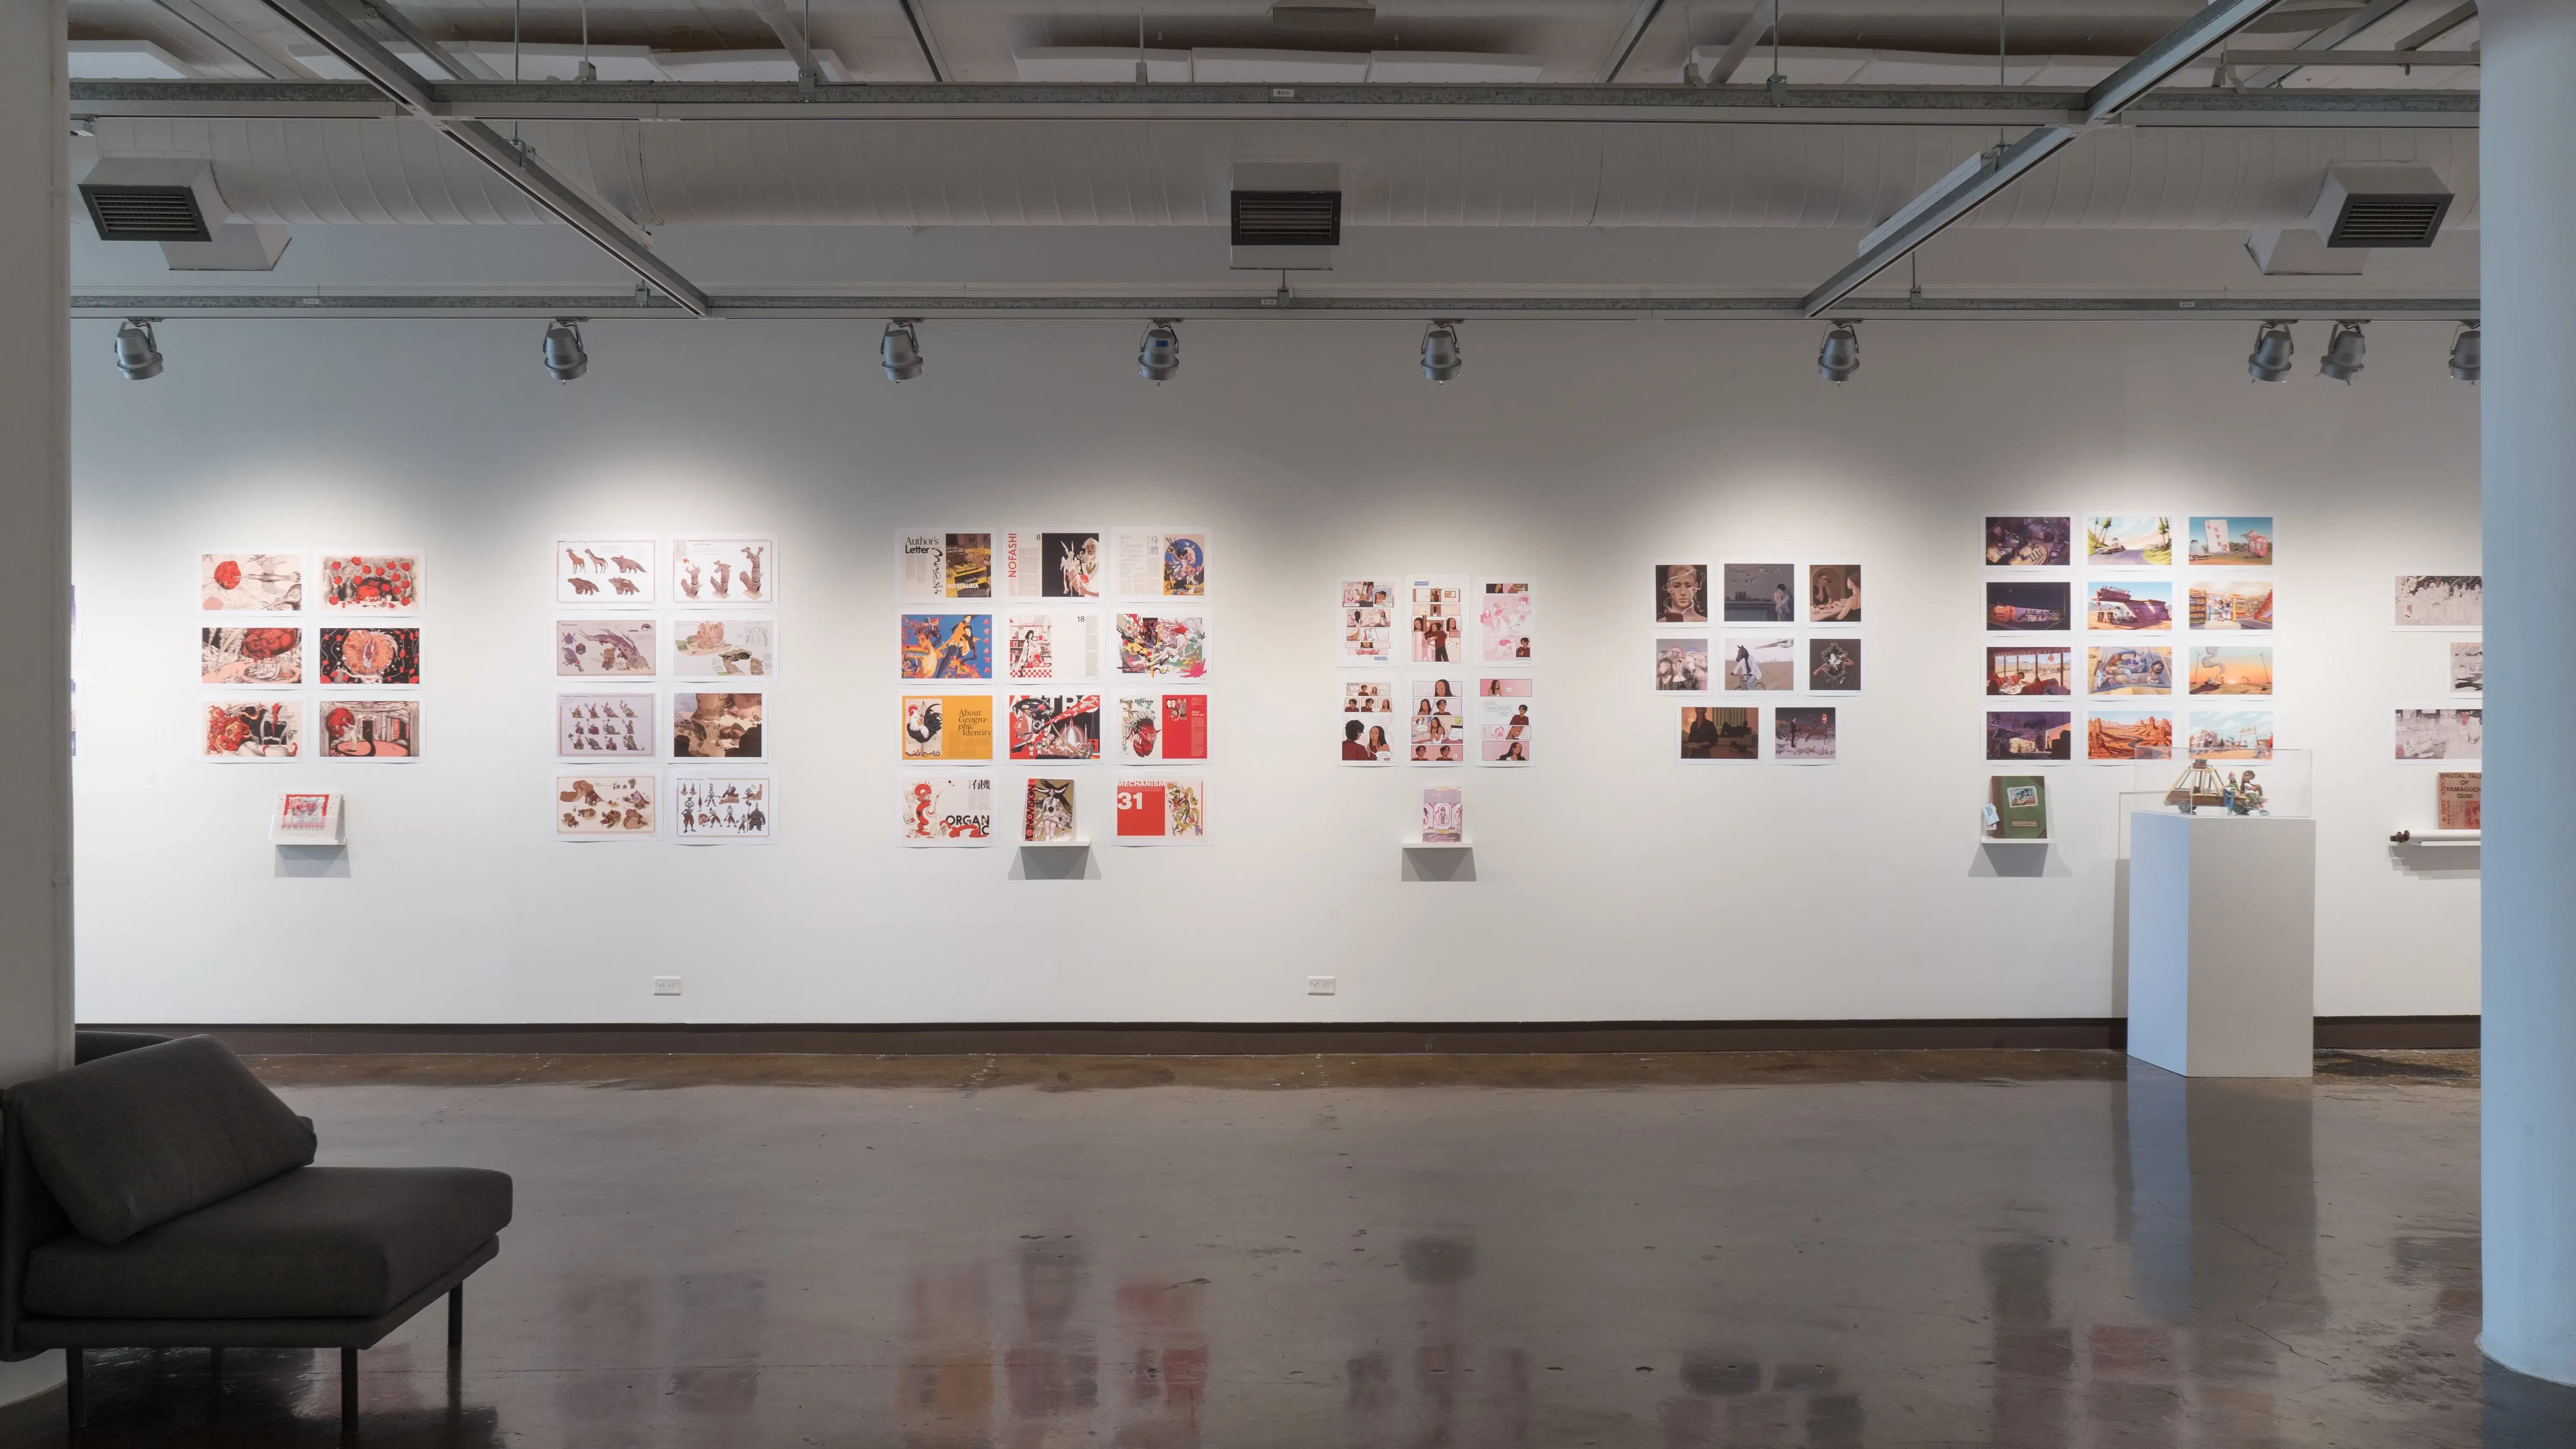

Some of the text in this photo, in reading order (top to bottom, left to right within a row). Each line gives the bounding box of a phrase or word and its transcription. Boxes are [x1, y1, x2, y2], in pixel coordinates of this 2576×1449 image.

[905, 537, 939, 545] Author's
[905, 545, 930, 554] Letter
[1008, 533, 1017, 577] NOFASHI
[959, 709, 981, 717] About
[958, 716, 989, 724] Geogra-
[972, 779, 990, 790] 有機
[1117, 792, 1142, 810] 31
